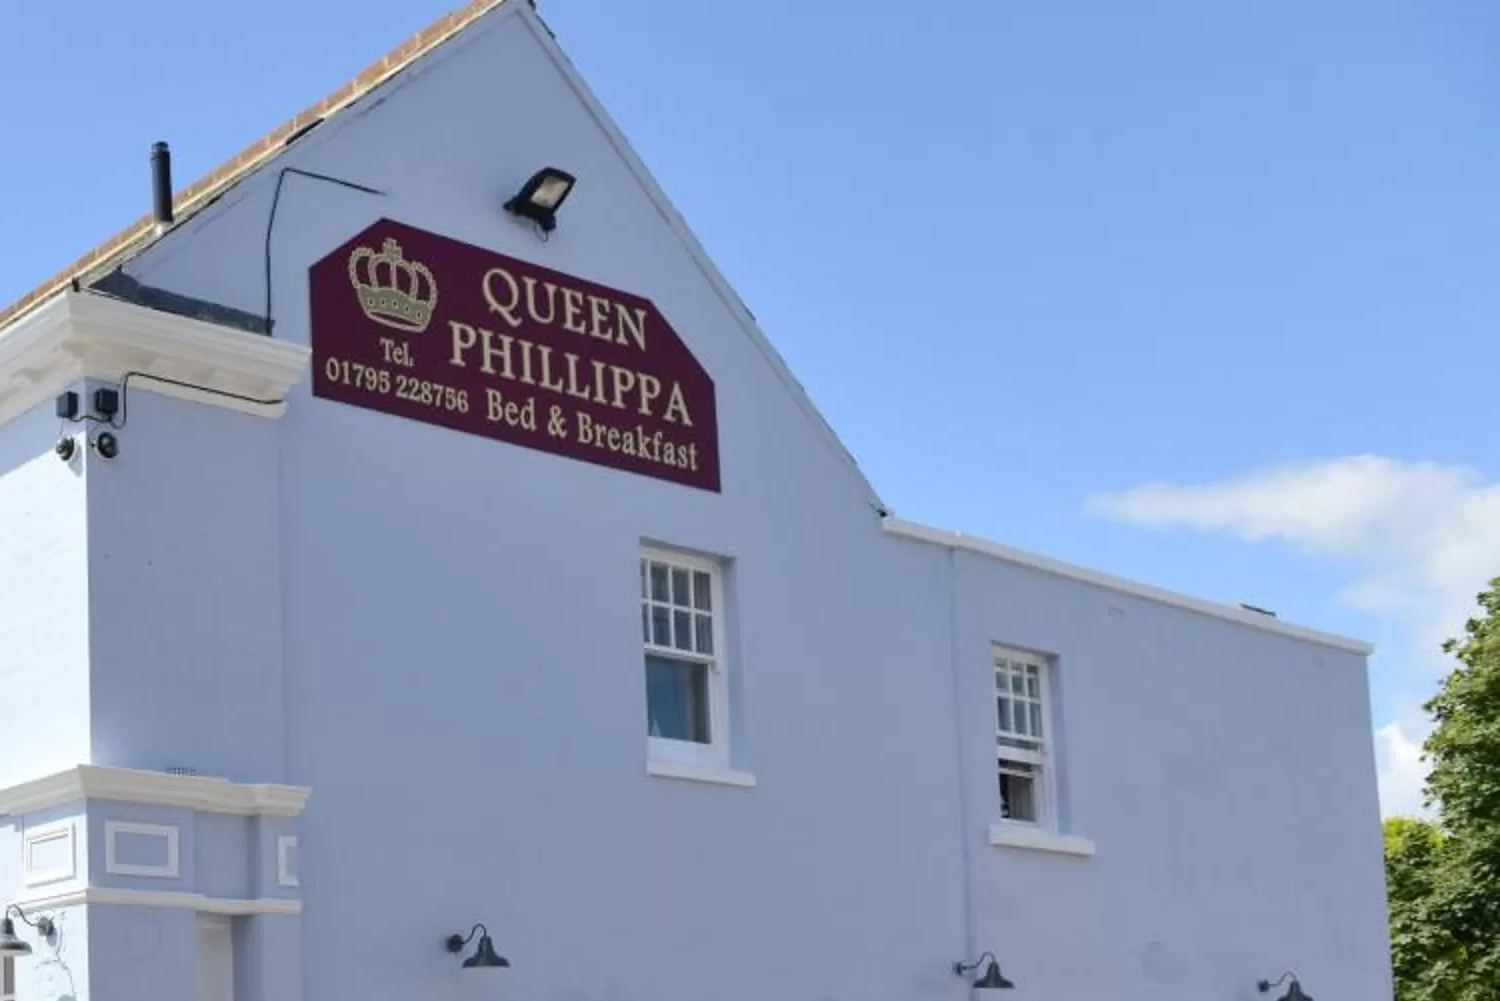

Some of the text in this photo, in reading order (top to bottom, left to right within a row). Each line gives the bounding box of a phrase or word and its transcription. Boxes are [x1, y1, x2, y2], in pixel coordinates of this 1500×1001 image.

[379, 336, 415, 367] Tel.
[482, 267, 647, 352] QUEEN
[325, 356, 469, 414] 01795 228756
[448, 320, 693, 428] PHILLIPPA
[485, 387, 698, 472] Bed & Breakfast
